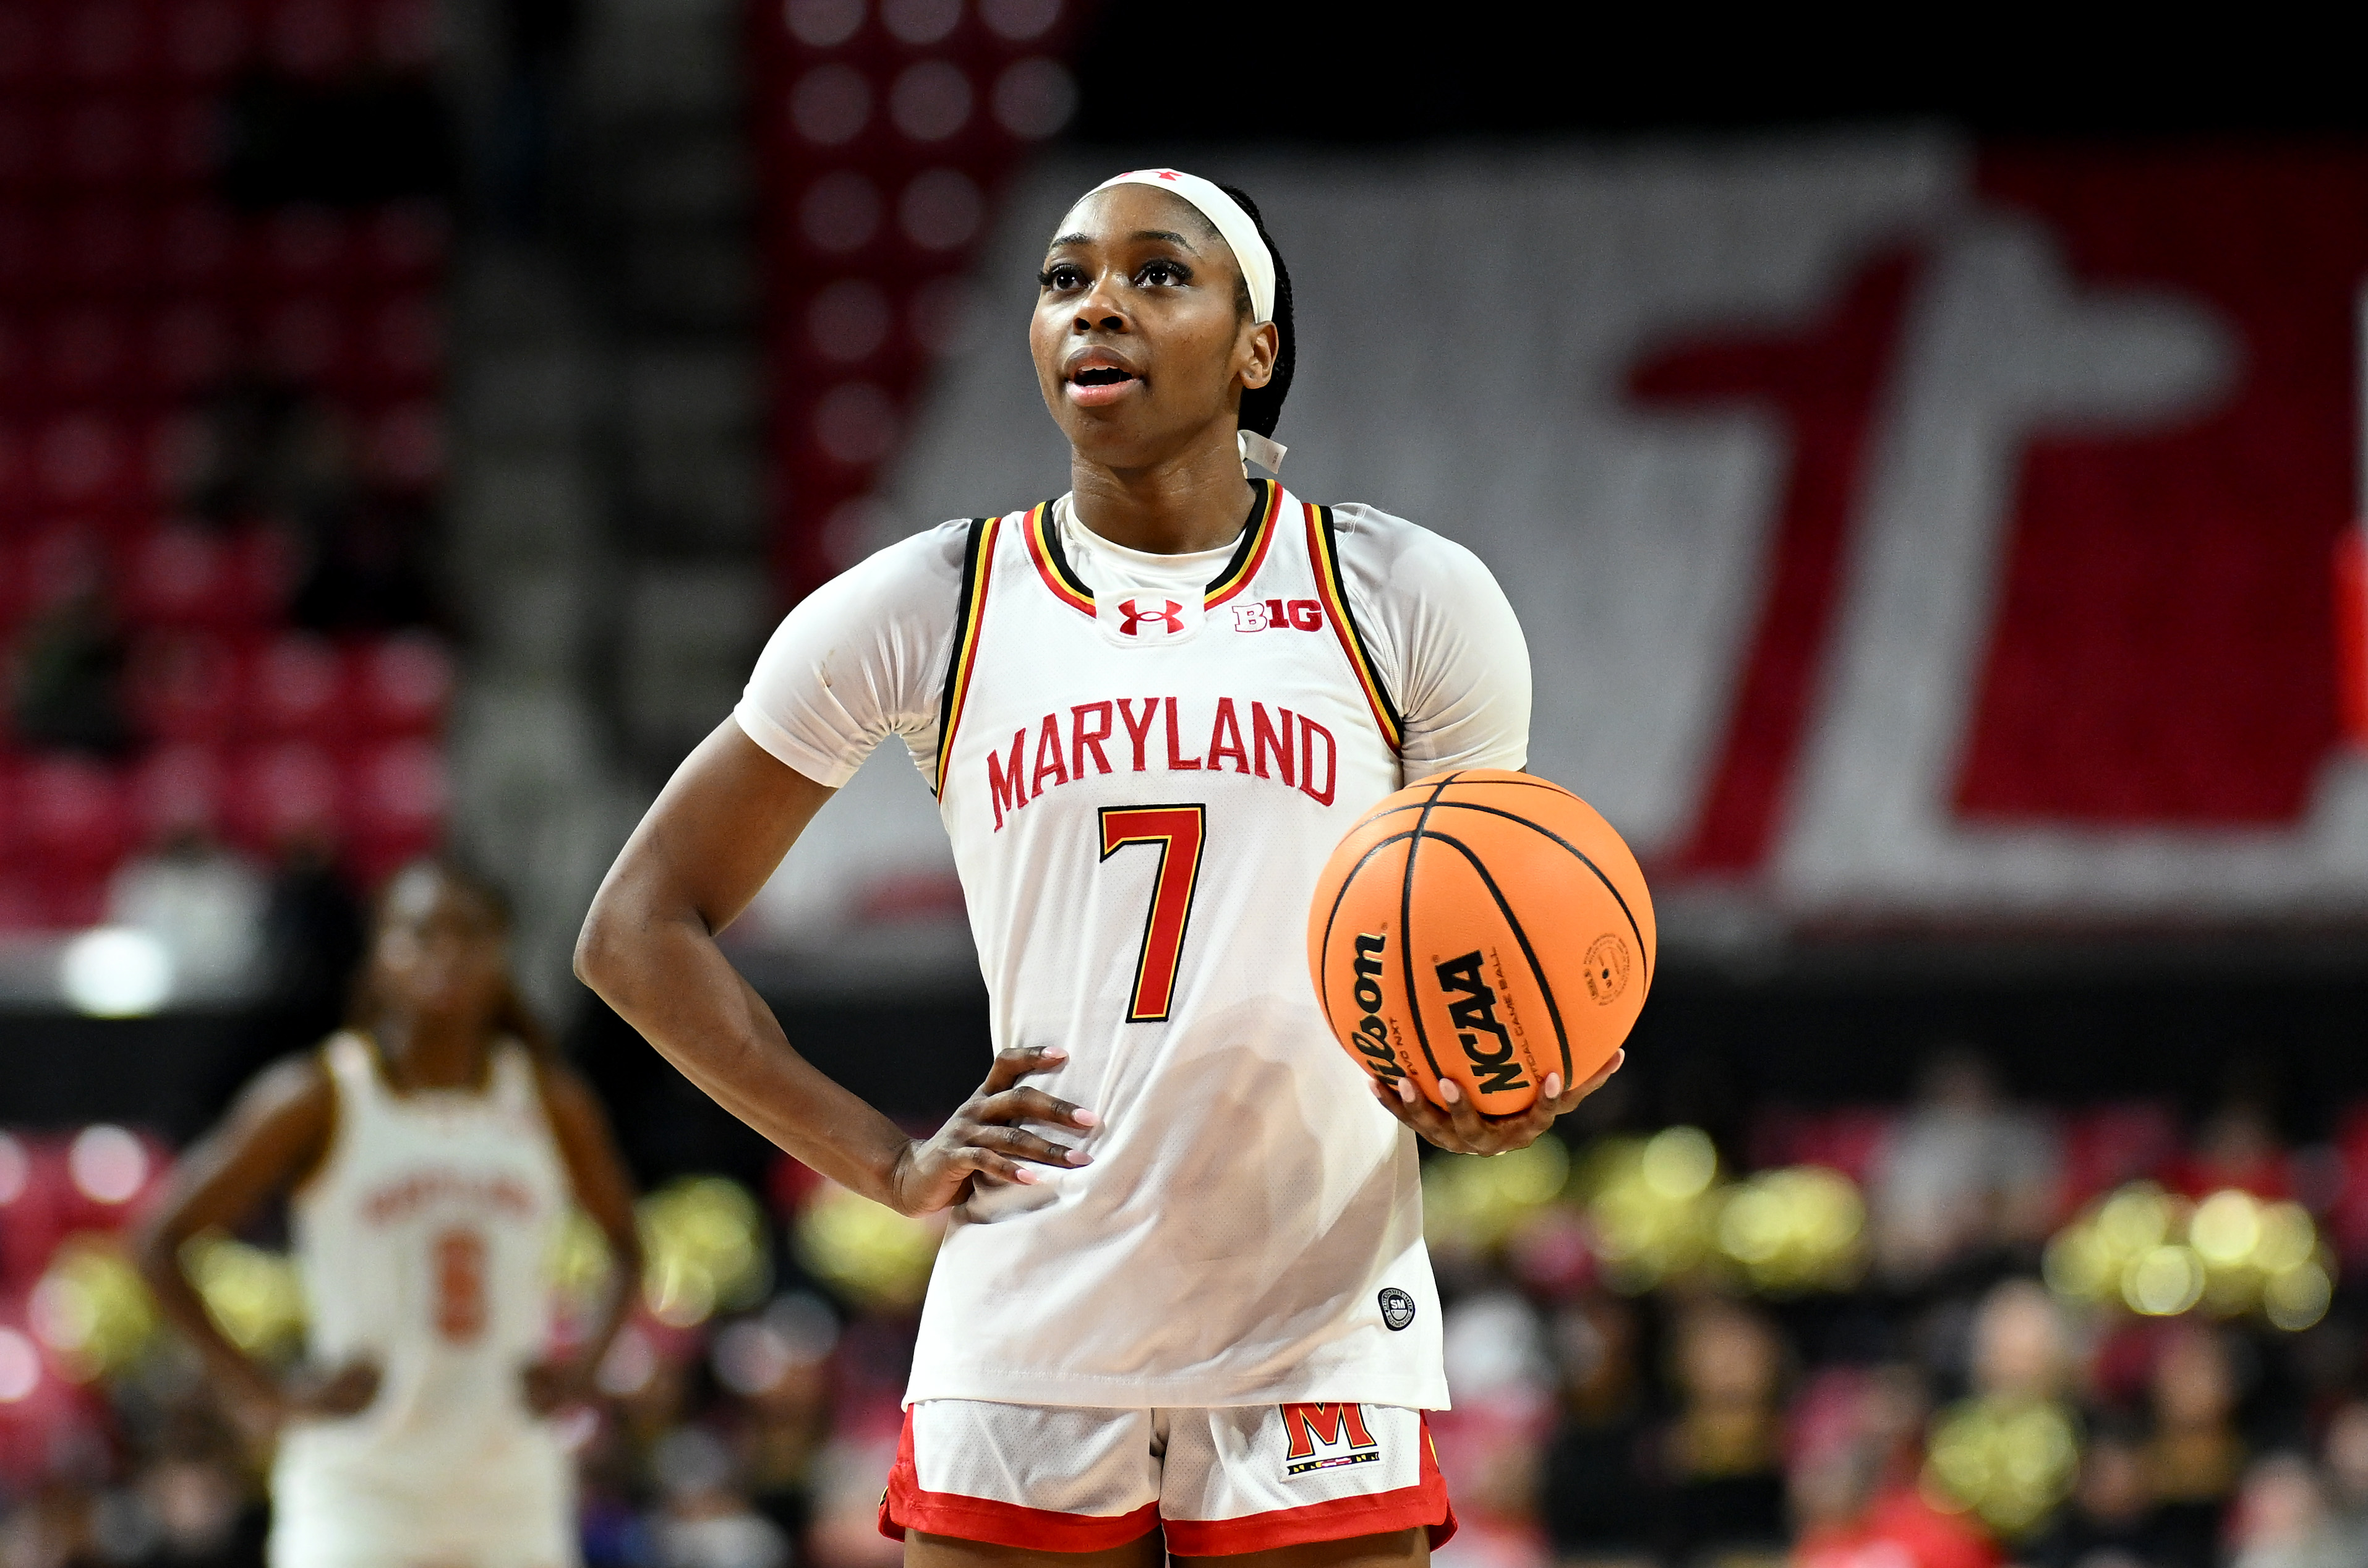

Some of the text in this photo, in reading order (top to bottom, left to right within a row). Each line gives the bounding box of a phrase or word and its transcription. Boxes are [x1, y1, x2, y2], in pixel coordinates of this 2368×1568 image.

[986, 696, 1336, 833] MARYLAND
[1097, 803, 1207, 1023] 7
[1490, 946, 1508, 991] BALL
[1351, 932, 1406, 1093] ilson
[1390, 1016, 1403, 1046] NXT
[1435, 949, 1531, 1094] NCAA
[1502, 992, 1524, 1037] GAME
[1390, 1299, 1406, 1310] SM
[1278, 1402, 1378, 1462] M
